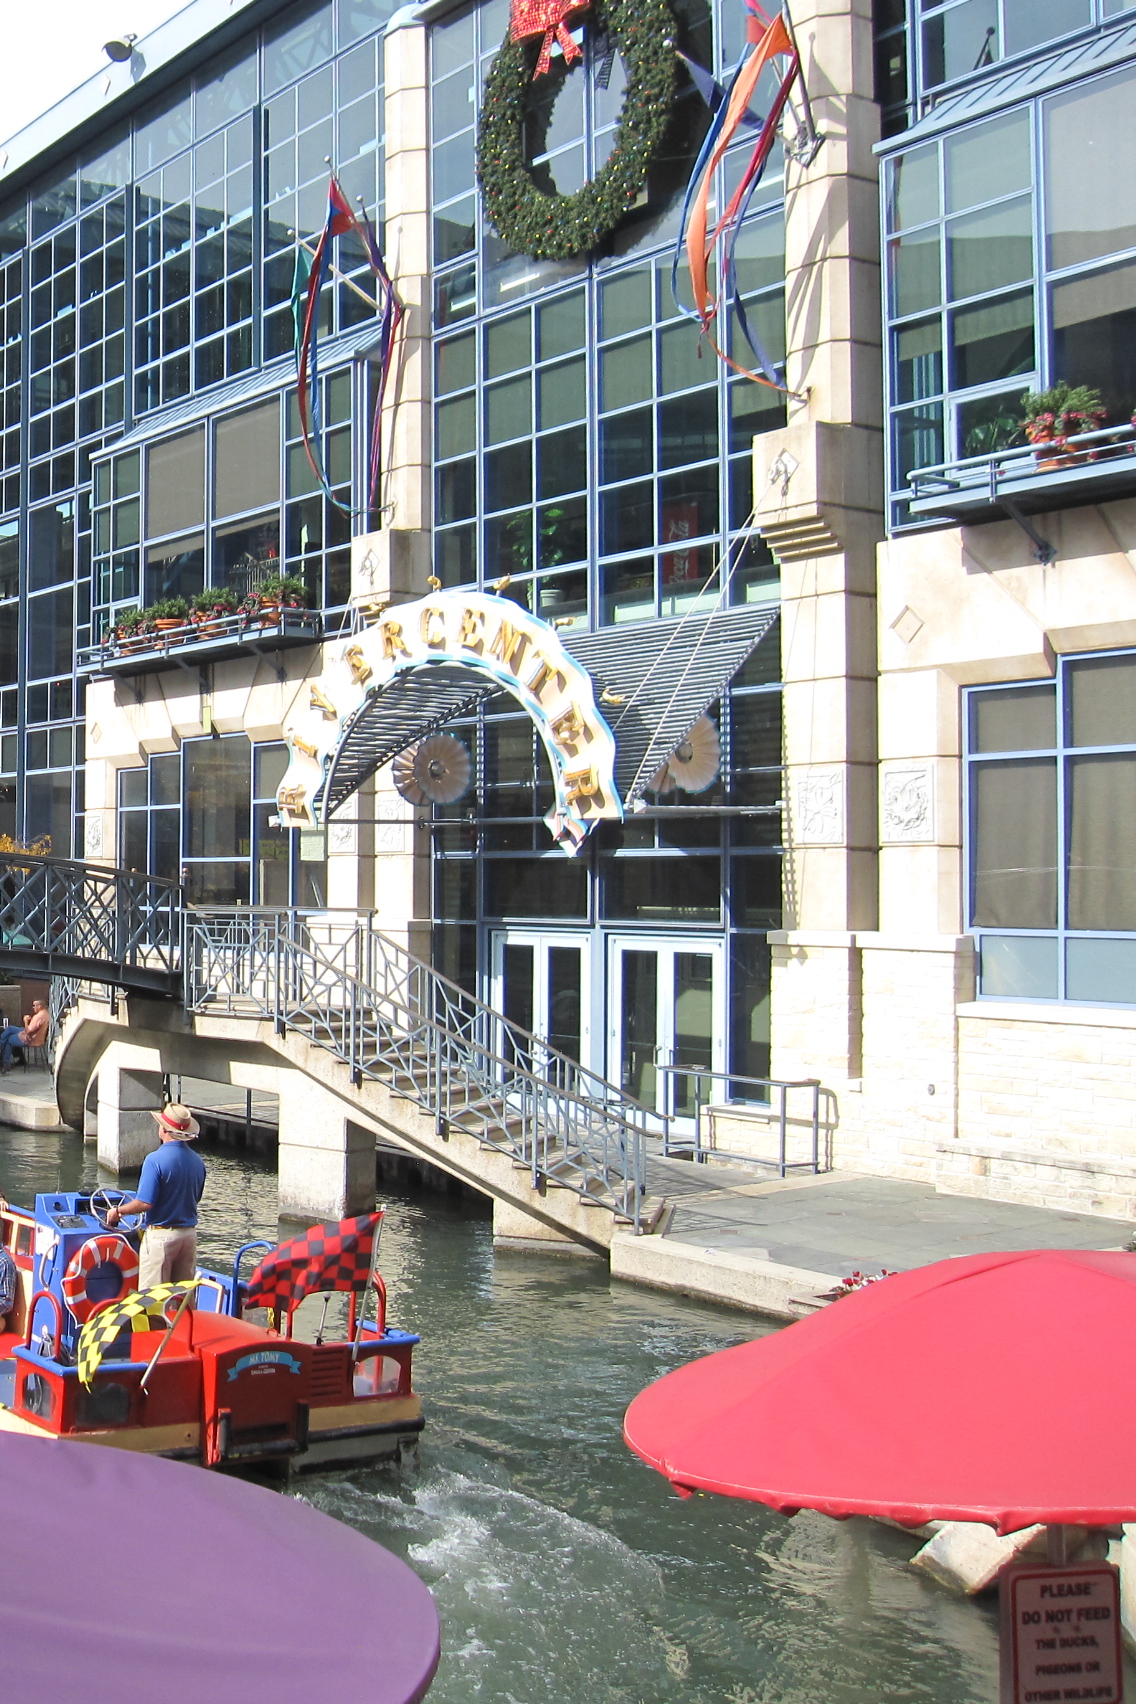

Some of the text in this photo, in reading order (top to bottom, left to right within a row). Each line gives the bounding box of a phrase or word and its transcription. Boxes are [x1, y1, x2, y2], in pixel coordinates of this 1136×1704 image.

[1039, 1582, 1091, 1598] PLEASE
[1021, 1606, 1111, 1625] DO NOT FEED
[1035, 1638, 1056, 1649] THE
[1085, 1661, 1100, 1672] OR
